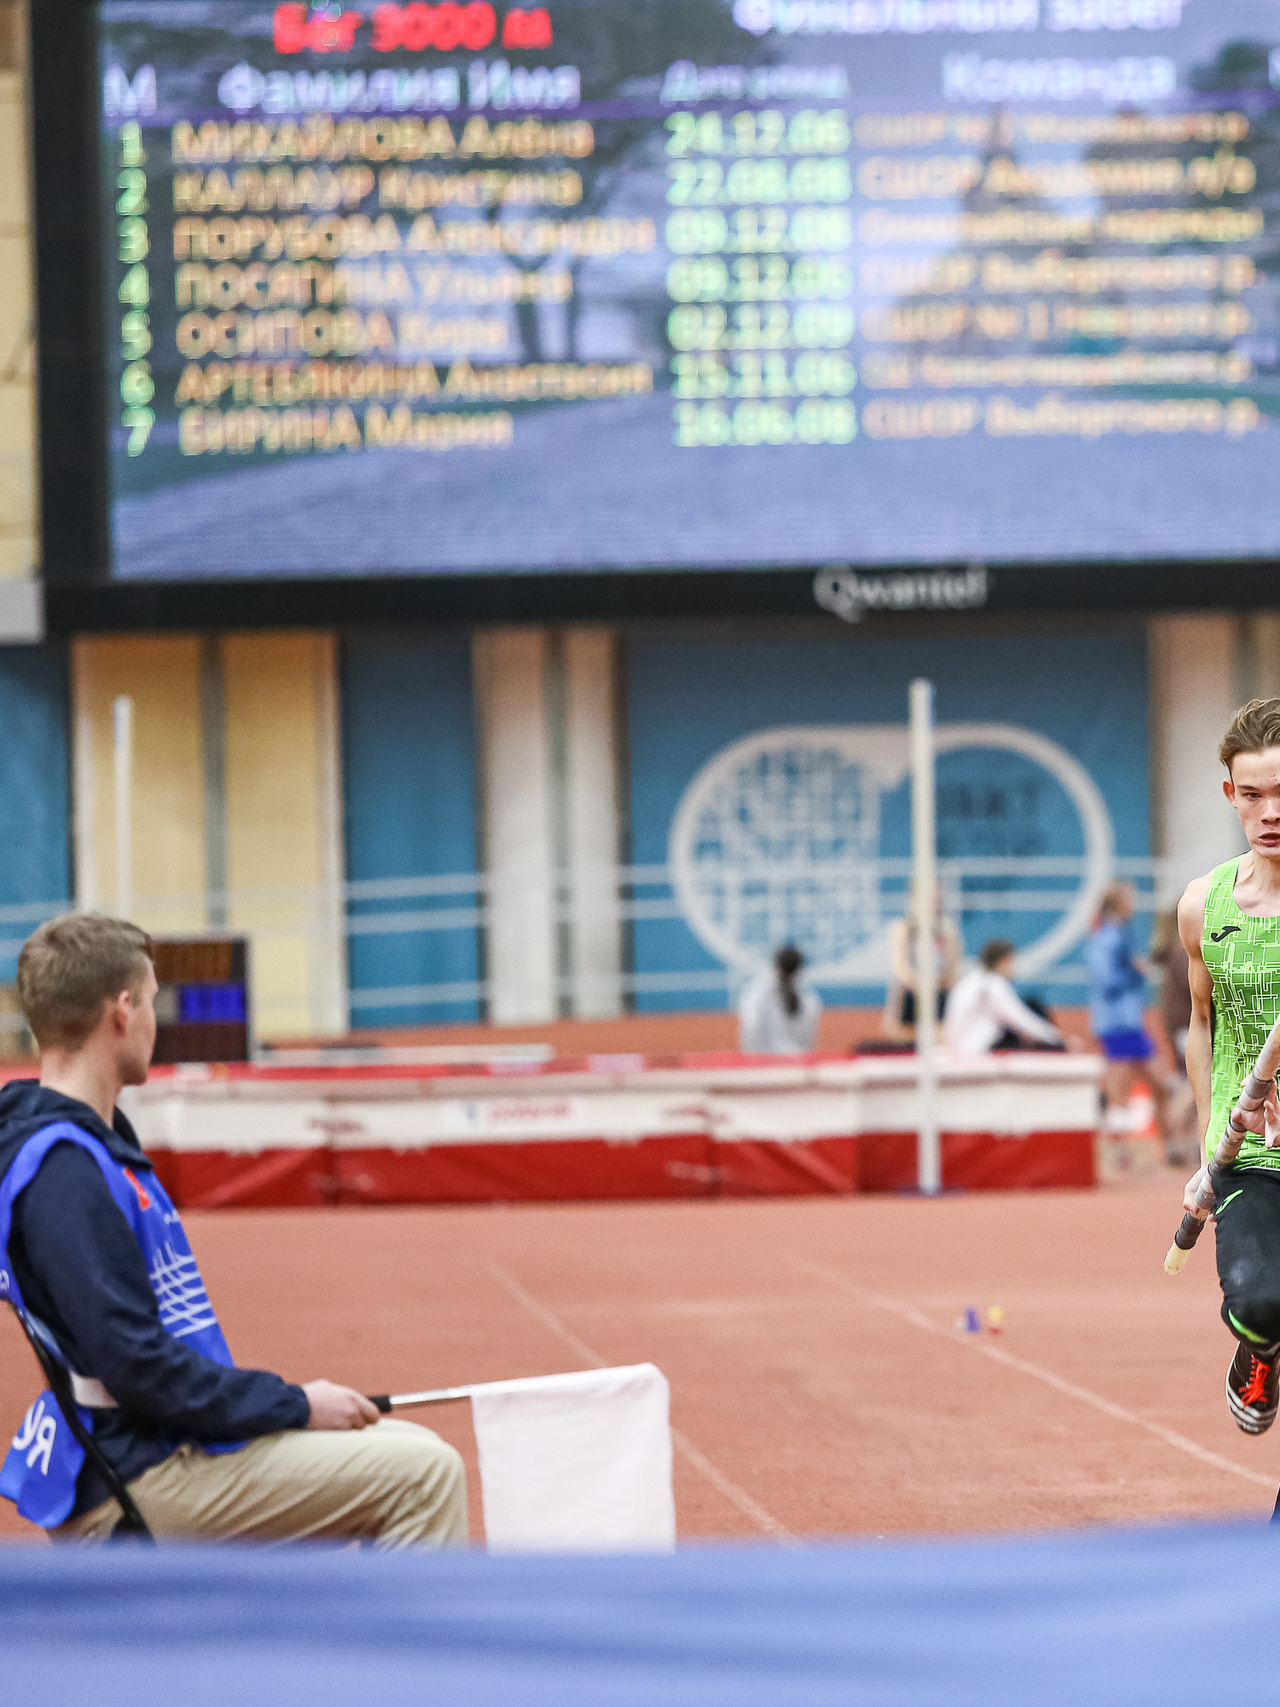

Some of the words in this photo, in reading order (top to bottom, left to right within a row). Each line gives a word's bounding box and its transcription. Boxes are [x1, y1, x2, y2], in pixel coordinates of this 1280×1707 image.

[371, 2, 496, 51] 3000
[217, 60, 460, 115] Фамилия
[467, 58, 581, 110] Имя
[942, 52, 1177, 102] Команда
[118, 120, 146, 167] 1
[171, 113, 456, 163] МИХАЙЛОВА
[116, 167, 148, 215] 2
[378, 165, 583, 213] Кристина
[117, 216, 149, 263] 3
[173, 213, 401, 262] ПОРУБОВА
[118, 262, 150, 309] 4
[121, 309, 153, 360] 5
[176, 308, 395, 359] ОСИПОВА
[120, 359, 155, 404] 6
[446, 356, 653, 399] Анастасия
[121, 406, 155, 456] 7
[178, 404, 361, 455] БИРИНА
[364, 402, 513, 452] Мария
[813, 564, 990, 624] Qwantel
